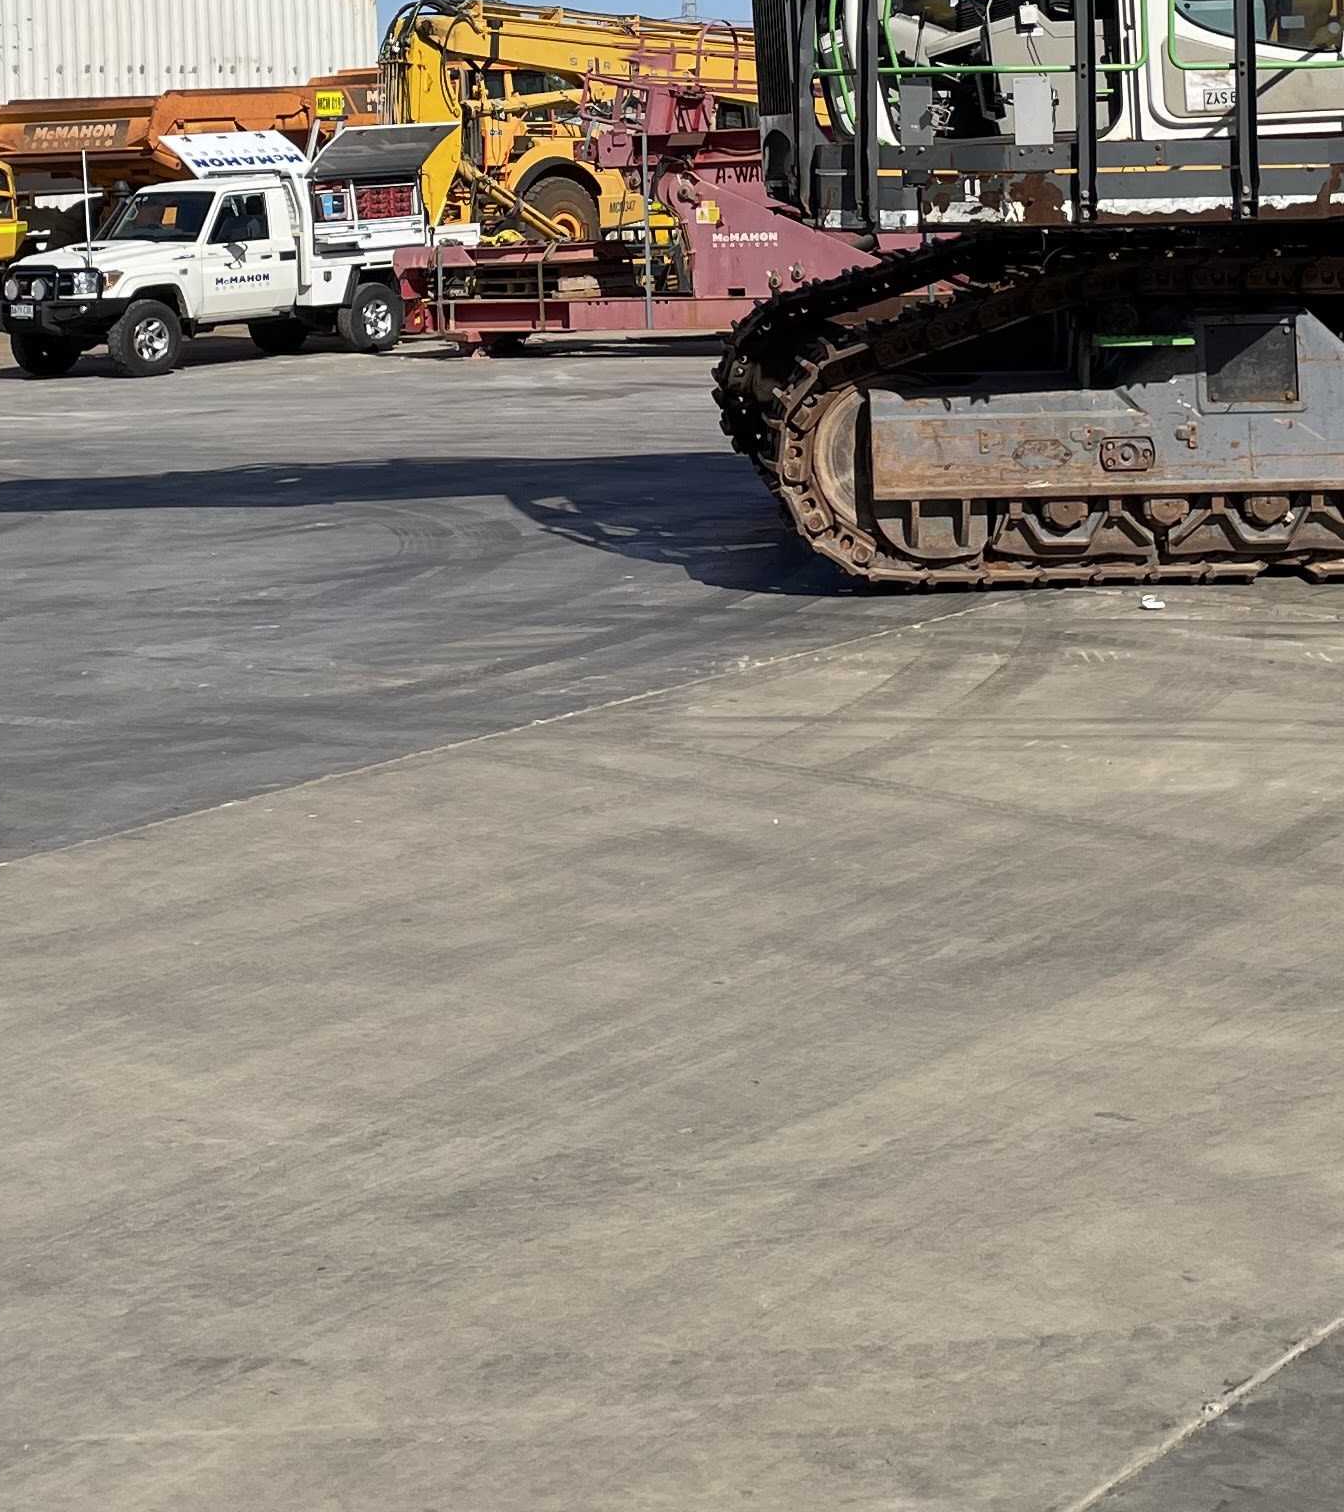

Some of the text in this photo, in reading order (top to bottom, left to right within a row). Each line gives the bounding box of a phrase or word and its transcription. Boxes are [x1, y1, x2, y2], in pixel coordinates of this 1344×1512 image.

[33, 123, 117, 140] McMAHON
[192, 153, 303, 168] McMAHON
[712, 232, 778, 242] McMAHON
[215, 273, 270, 285] McMAHON
